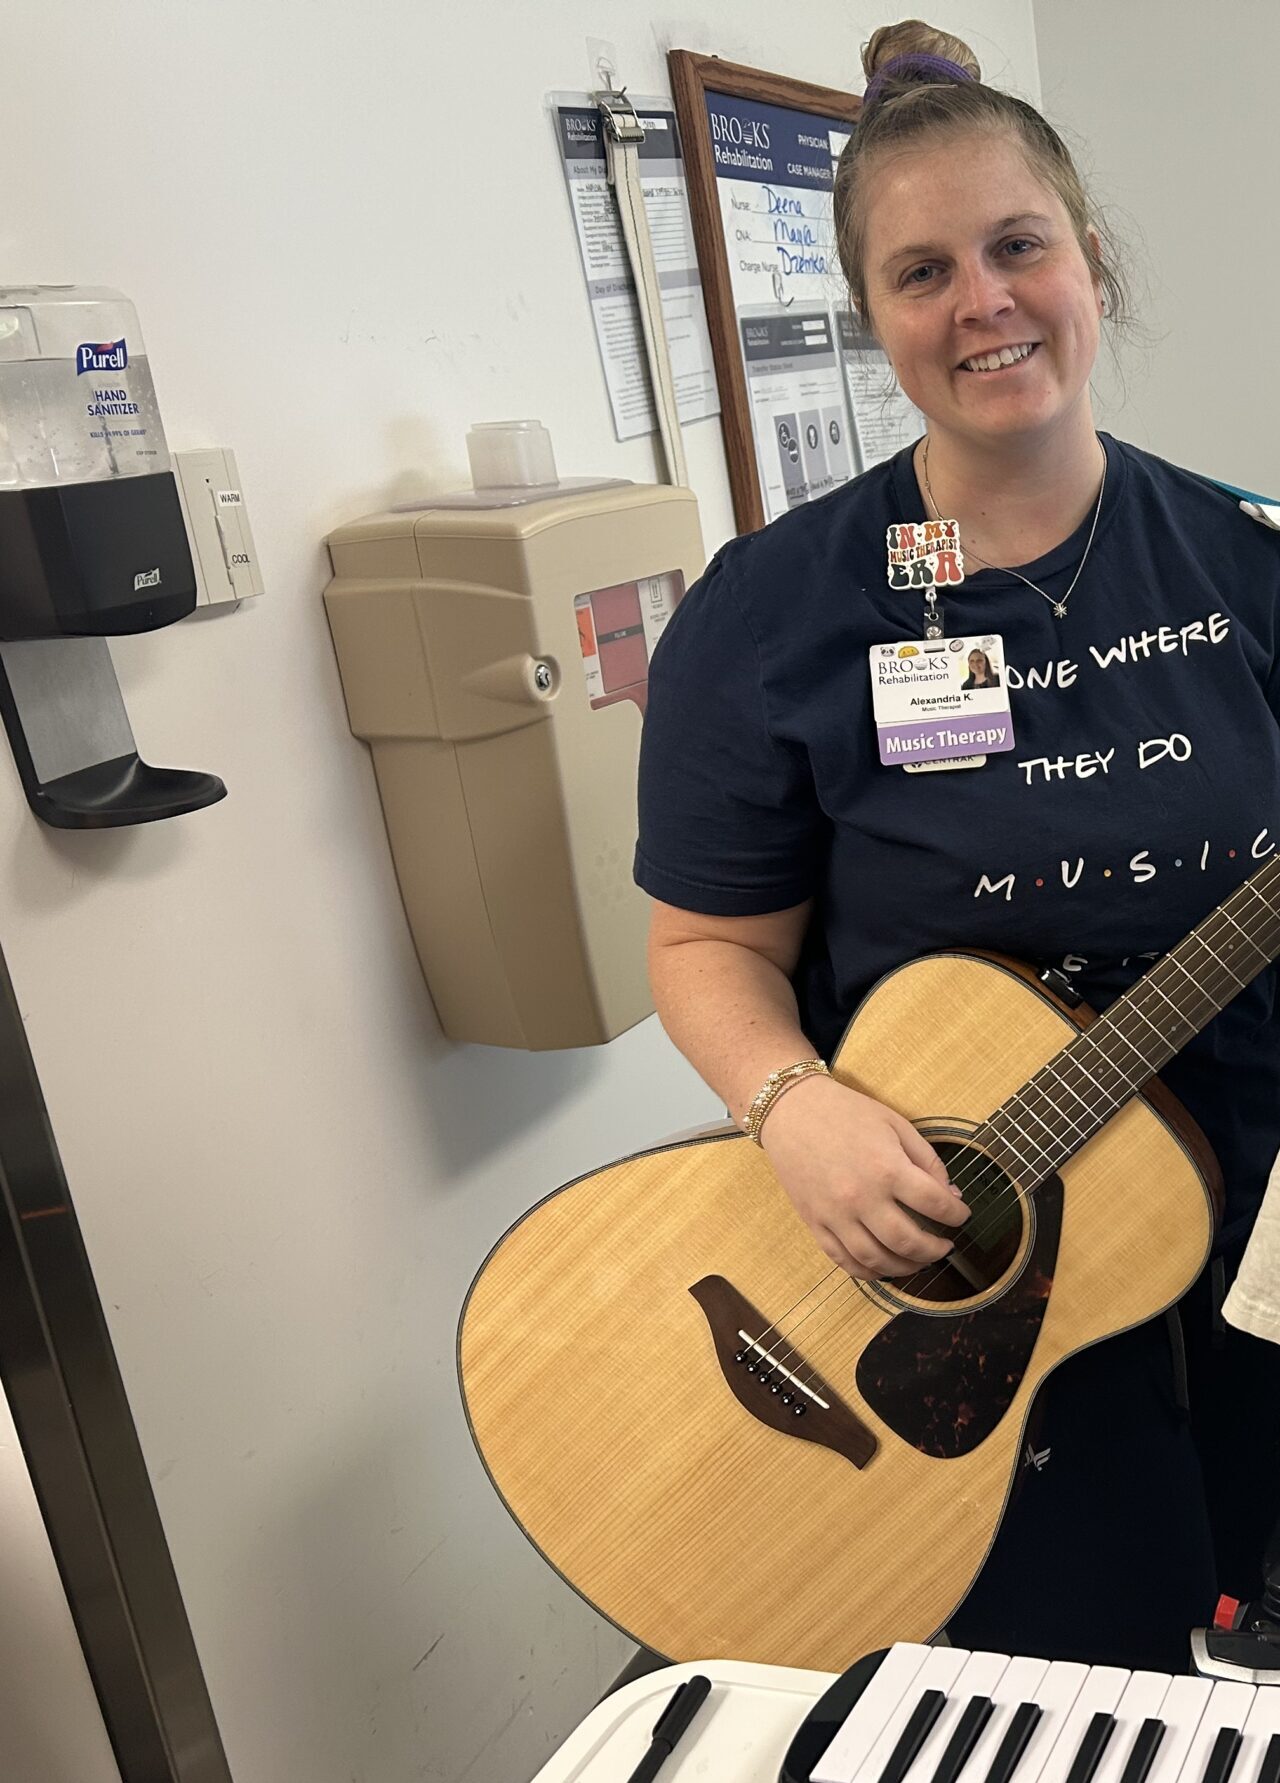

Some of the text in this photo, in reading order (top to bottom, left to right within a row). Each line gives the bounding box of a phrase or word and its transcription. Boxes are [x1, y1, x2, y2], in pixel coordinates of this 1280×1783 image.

[710, 113, 770, 150] BROOKS
[714, 144, 773, 172] Rehabilitation
[81, 346, 125, 369] Purell
[94, 389, 127, 402] HAND
[87, 402, 140, 417] SANITIZER
[220, 493, 241, 503] WARM
[889, 521, 956, 550] IN MY
[232, 553, 250, 564] COOL
[890, 538, 958, 563] MUSIC THERAPIST
[890, 551, 962, 588] ERA
[1005, 612, 1231, 690] ONE WHERE
[878, 656, 949, 675] BROOKS
[878, 672, 949, 686] Rehabilitation
[910, 693, 973, 706] Alexandria K.
[886, 727, 1007, 754] Music Therapy
[1017, 733, 1193, 785] THEY DO
